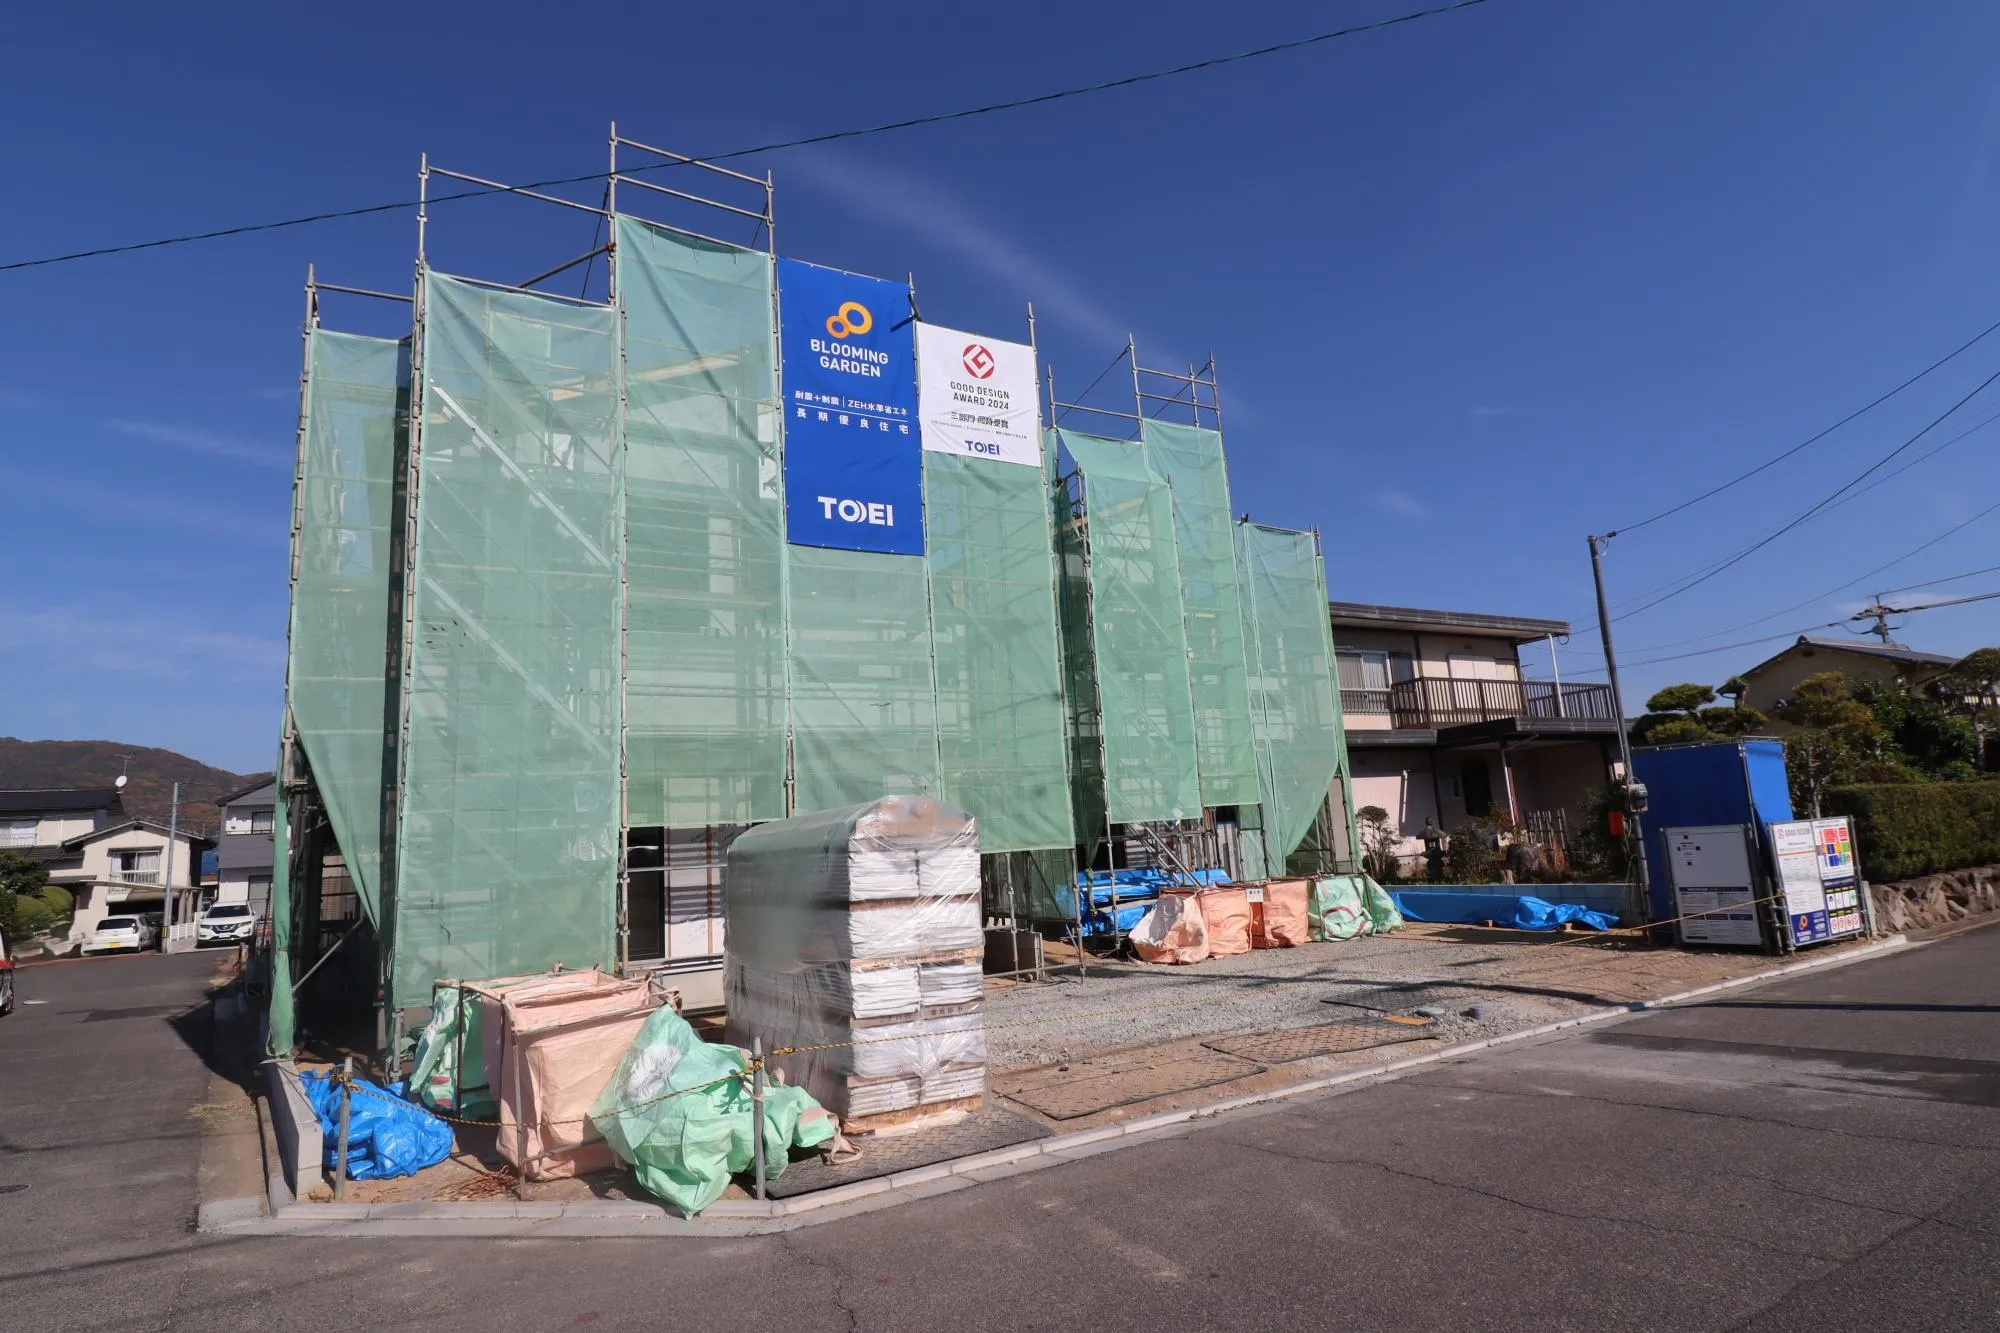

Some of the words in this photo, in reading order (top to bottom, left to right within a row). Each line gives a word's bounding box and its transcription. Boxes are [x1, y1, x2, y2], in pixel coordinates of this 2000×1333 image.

[810, 339, 888, 365] BLOOMING
[820, 357, 881, 377] GARDEN
[950, 381, 974, 393] GOOD
[977, 387, 1010, 400] DESIGN
[953, 392, 985, 405] AWARD
[988, 399, 1009, 410] 2024
